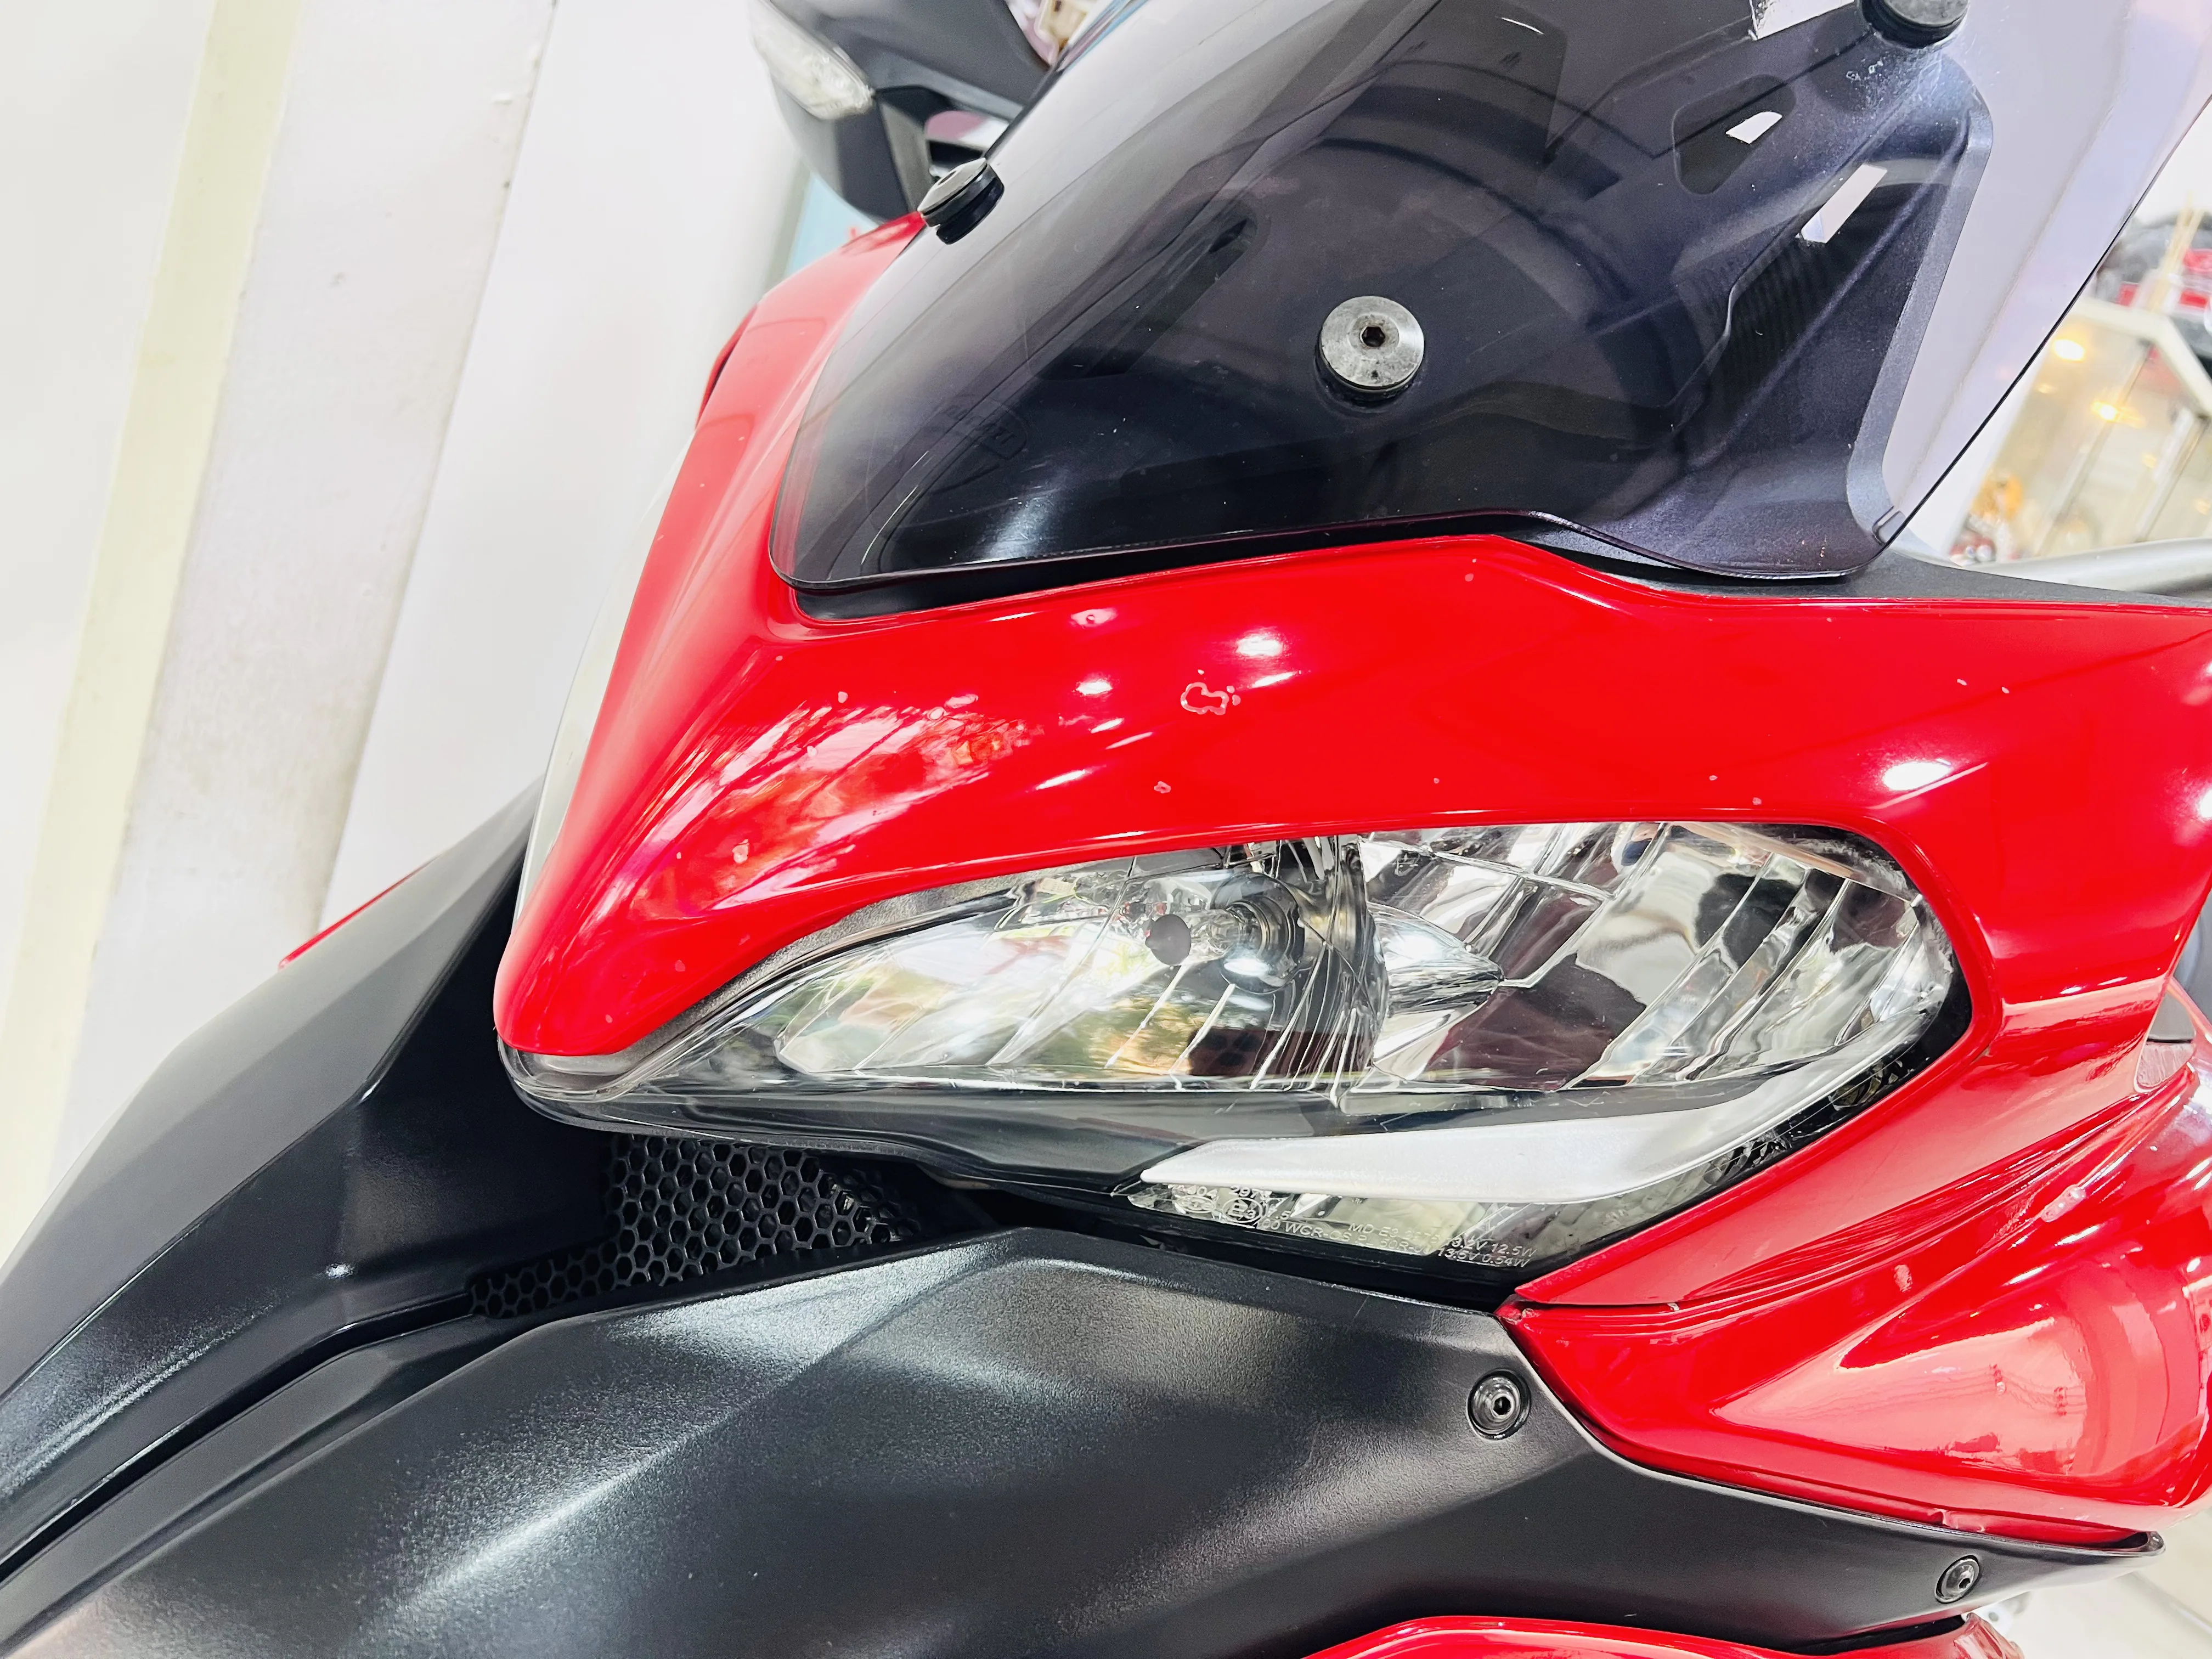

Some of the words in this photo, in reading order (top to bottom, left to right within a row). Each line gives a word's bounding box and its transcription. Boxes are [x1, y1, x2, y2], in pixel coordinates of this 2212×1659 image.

[1347, 1222, 1374, 1234] MD
[1379, 1226, 1399, 1238] E3
[1491, 1243, 1537, 1257] 12.5W
[1438, 1247, 1481, 1261] 13.5V
[1482, 1253, 1531, 1268] 0.54W
